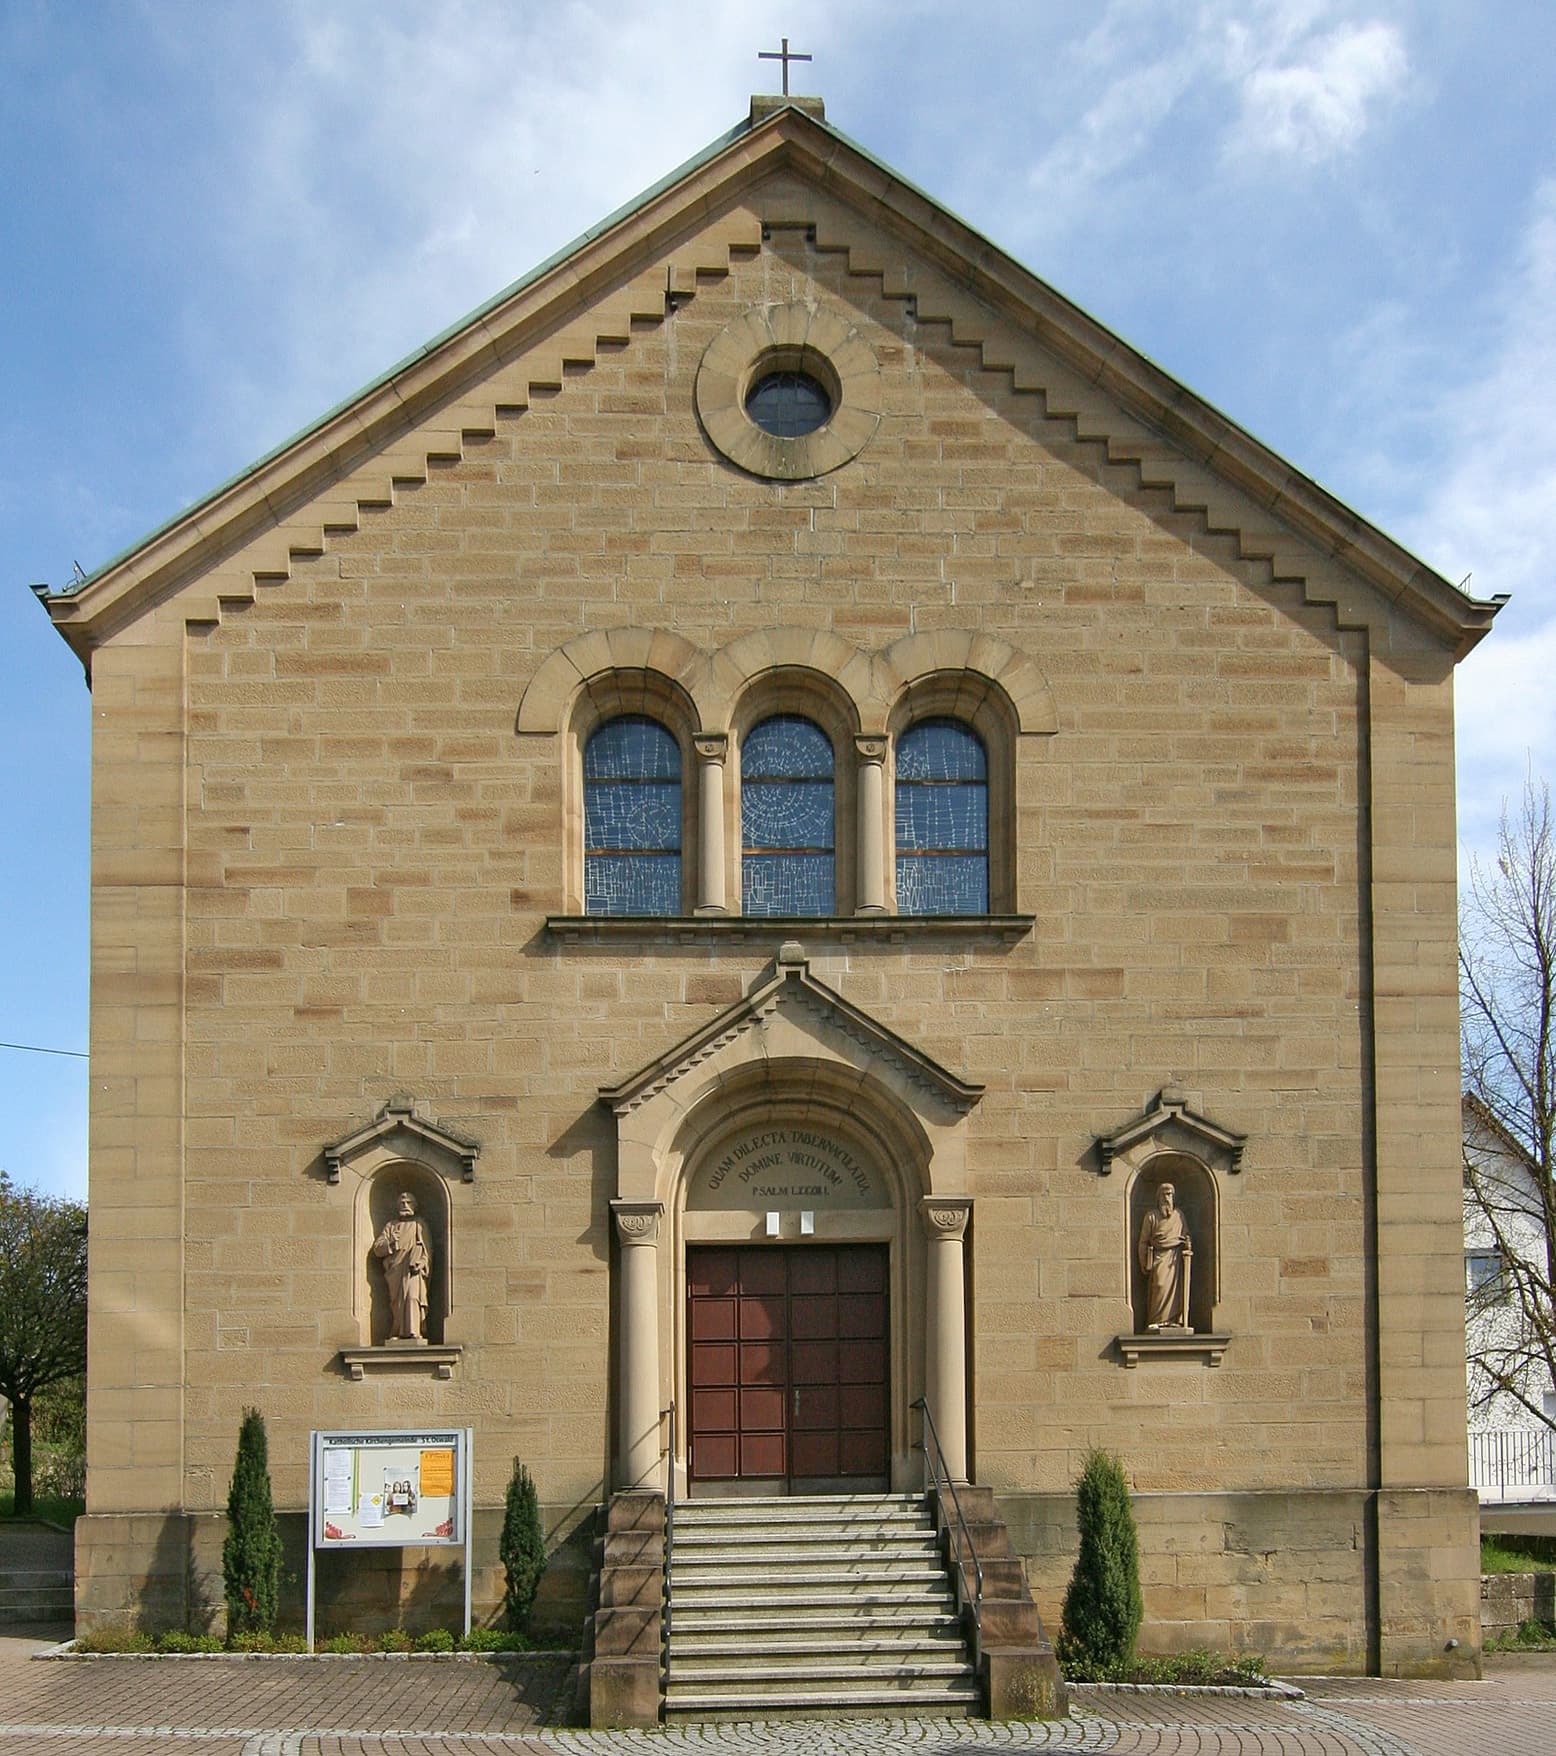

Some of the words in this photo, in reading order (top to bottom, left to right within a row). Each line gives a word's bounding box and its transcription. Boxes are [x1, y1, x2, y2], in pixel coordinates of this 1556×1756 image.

[708, 1155, 736, 1190] QUAM
[732, 1131, 787, 1160] DILECTA
[738, 1152, 782, 1183] DOMINE
[752, 1186, 788, 1196] PSALM
[365, 1437, 418, 1446] Kirchengemeinde
